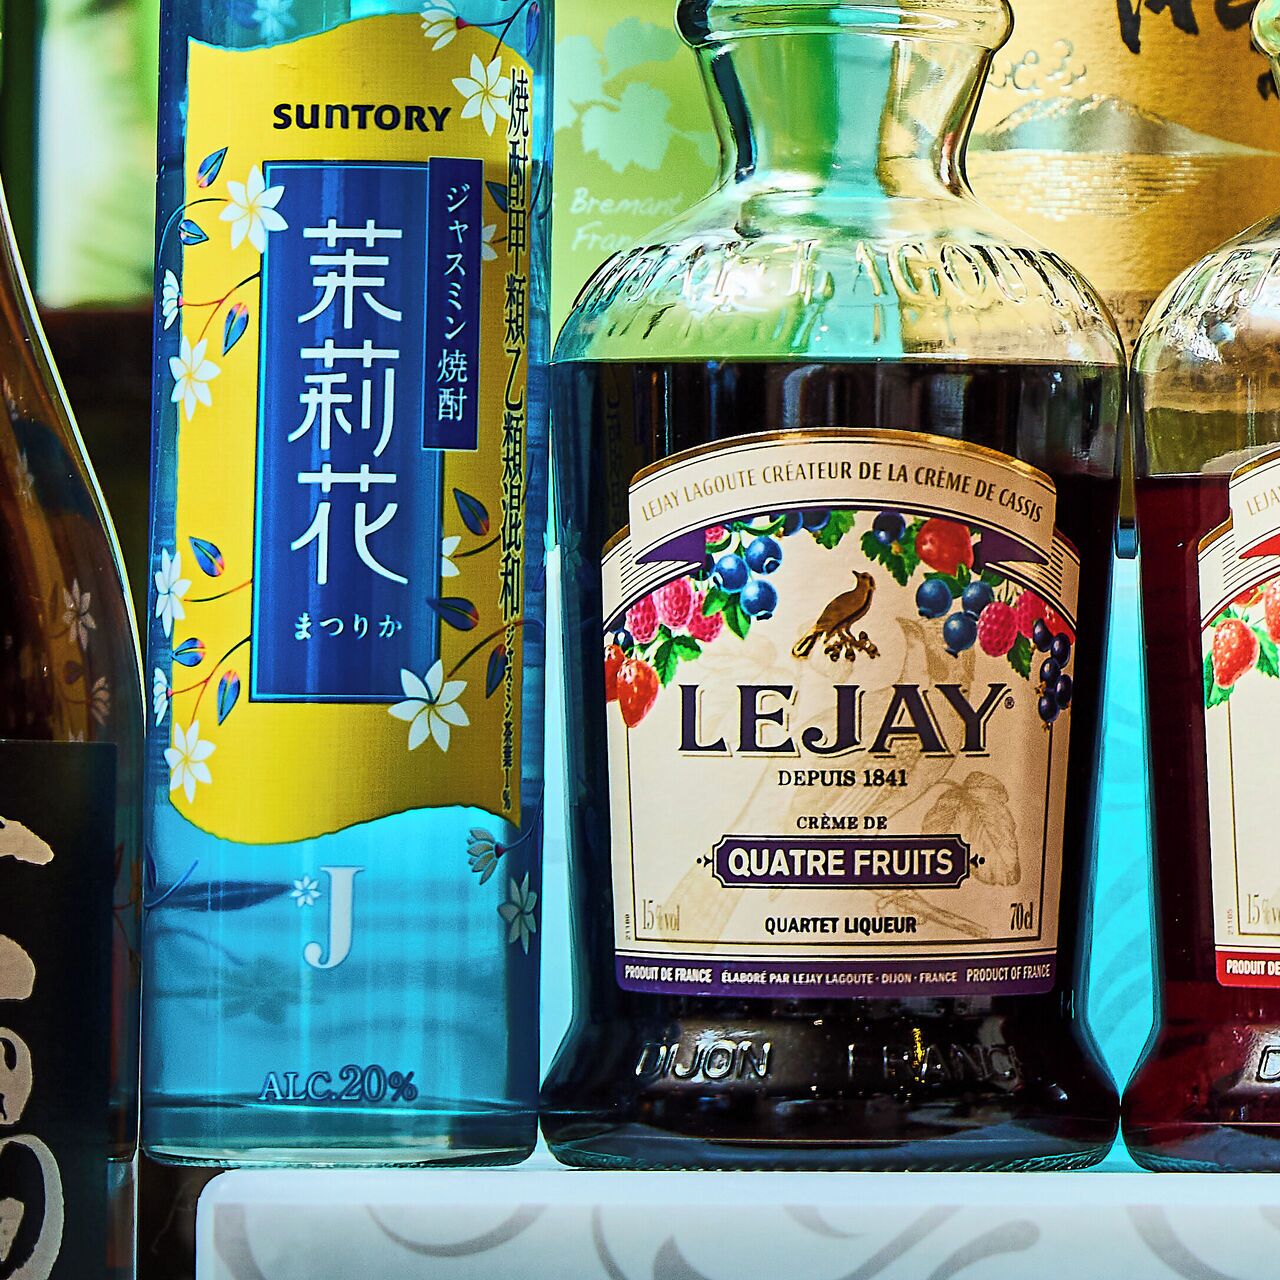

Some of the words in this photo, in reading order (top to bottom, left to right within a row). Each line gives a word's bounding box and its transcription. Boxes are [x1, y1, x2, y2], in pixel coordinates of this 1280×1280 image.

[438, 182, 471, 422] ジャスミン焼酎
[288, 218, 410, 585] 茉莉花
[294, 614, 404, 641] まつりか
[678, 684, 1008, 752] LEJAY
[778, 770, 855, 787] DEPUIS
[863, 770, 908, 787] 1841
[796, 814, 858, 830] CRÈME
[864, 816, 887, 830] DE
[728, 848, 846, 877] QUATRE
[854, 848, 953, 875] FRUITS
[303, 864, 365, 970] J
[765, 917, 838, 936] QUARTET
[844, 917, 918, 934] LIQUEUR
[258, 1065, 419, 1102] ALC.20%
